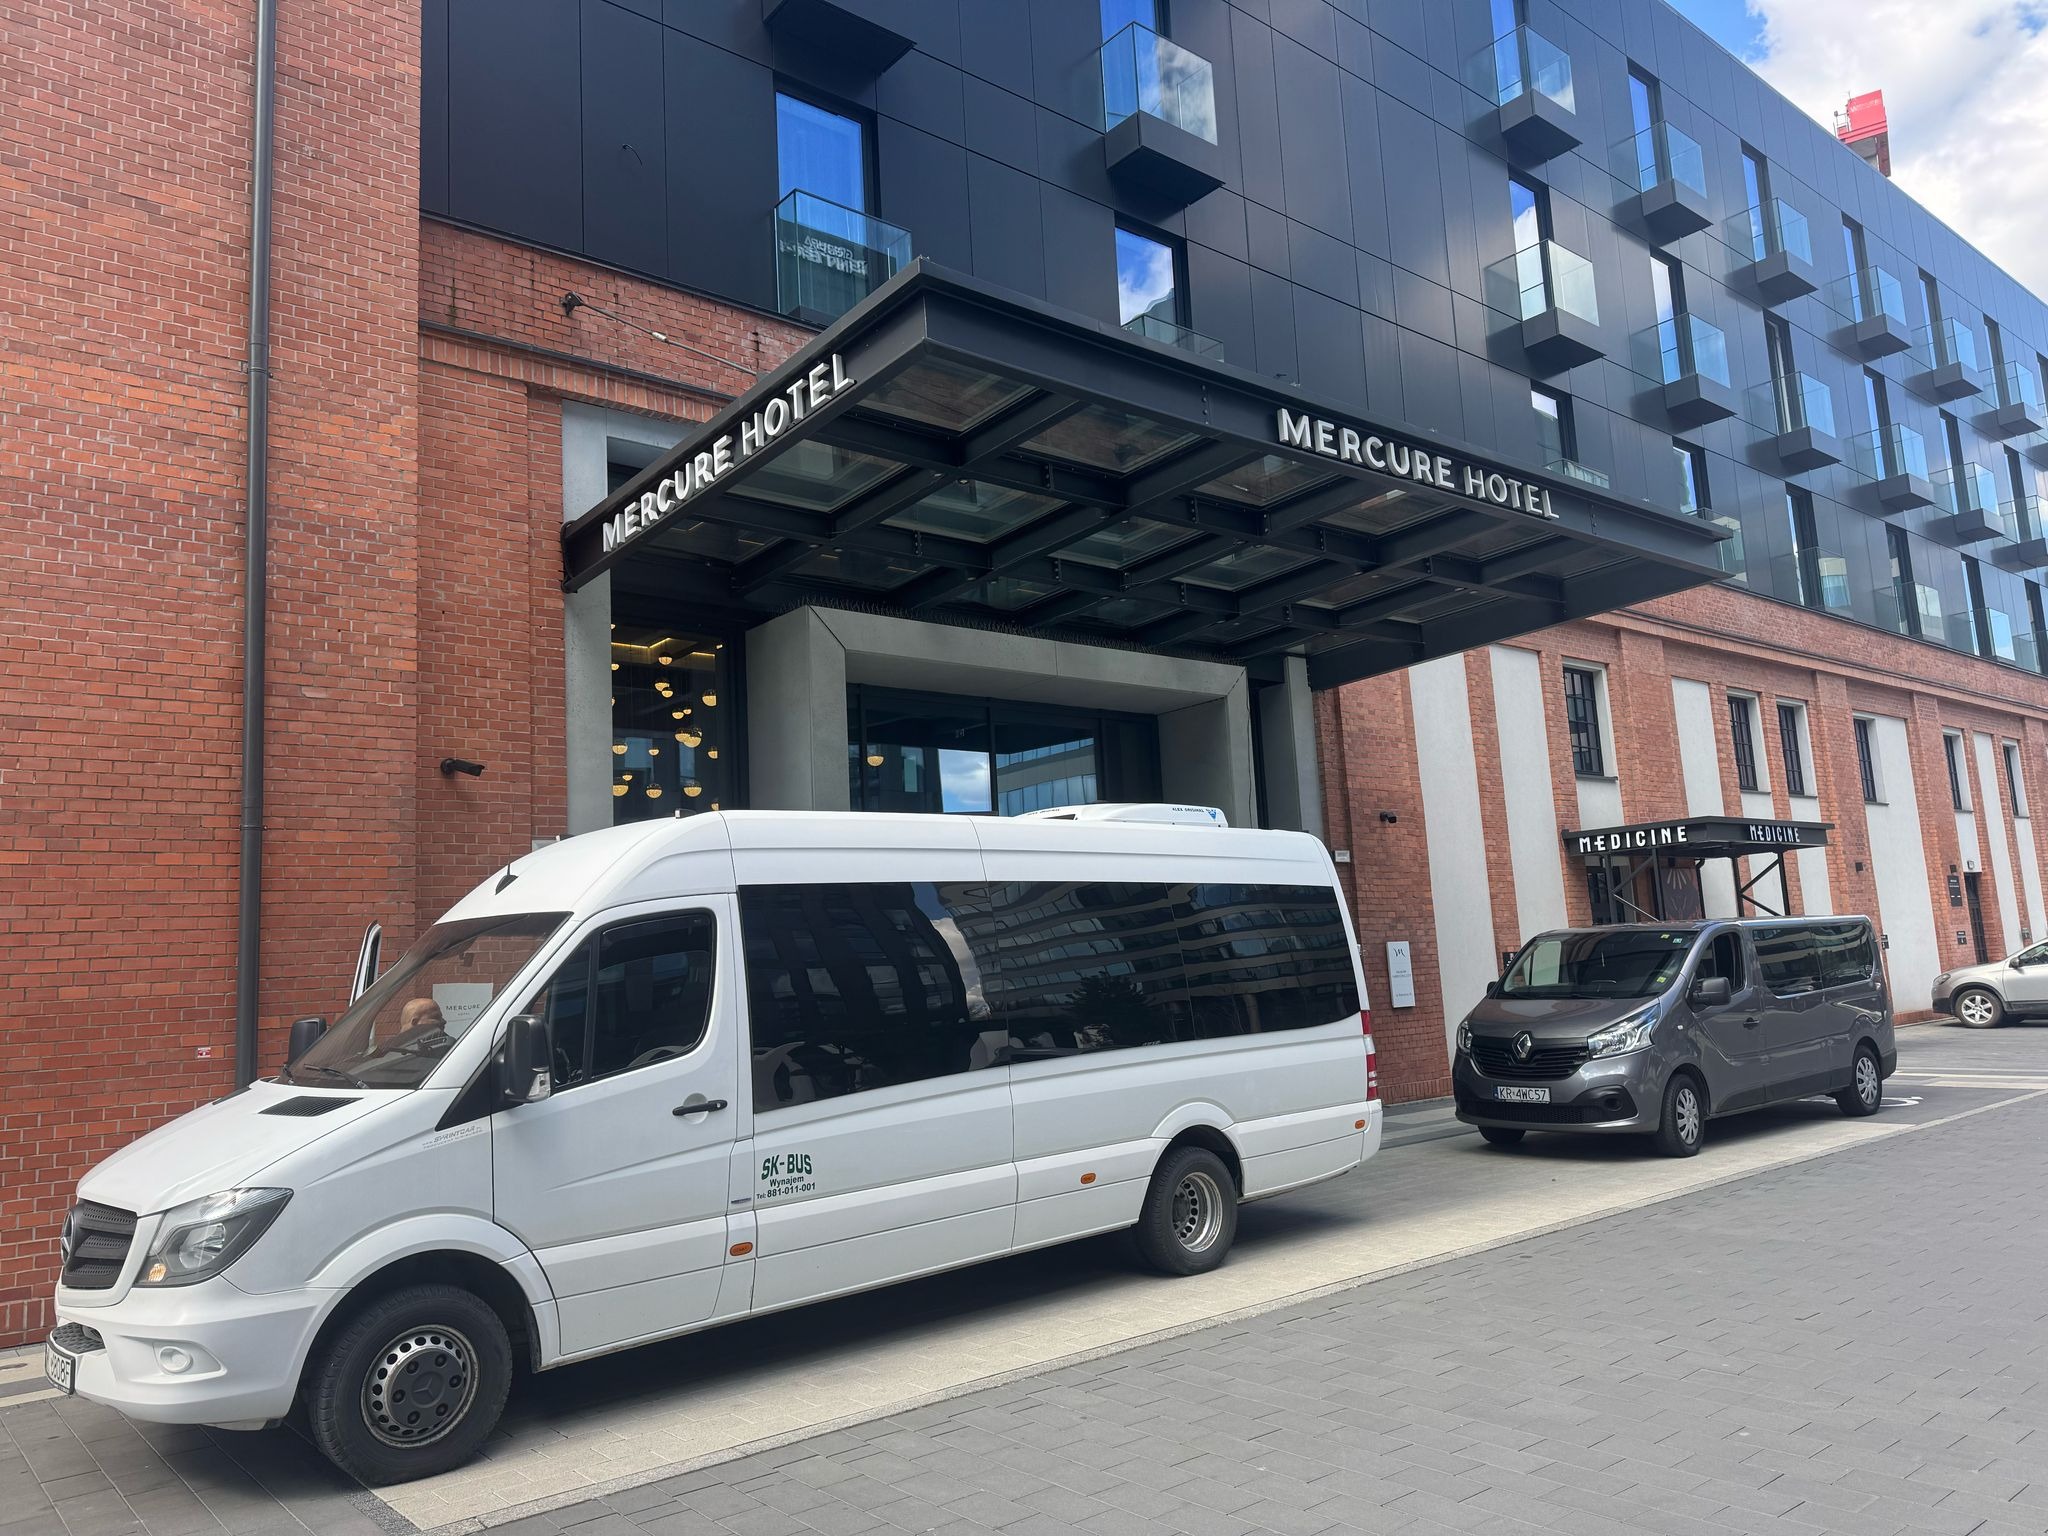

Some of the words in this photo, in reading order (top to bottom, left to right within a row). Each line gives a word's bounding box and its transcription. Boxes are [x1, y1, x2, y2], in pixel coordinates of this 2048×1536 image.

[603, 434, 735, 553] MERCURE
[741, 353, 856, 456] HOTEL
[1277, 407, 1455, 489] MERCURE
[1463, 465, 1560, 519] HOTEL
[1579, 826, 1688, 853] MEDICINE
[1750, 824, 1801, 843] MEDICINE
[445, 1003, 481, 1012] MERCURE
[761, 1153, 813, 1180] SK-BUS
[767, 1182, 816, 1198] 881-011-001
[769, 1175, 804, 1188] Wynajem
